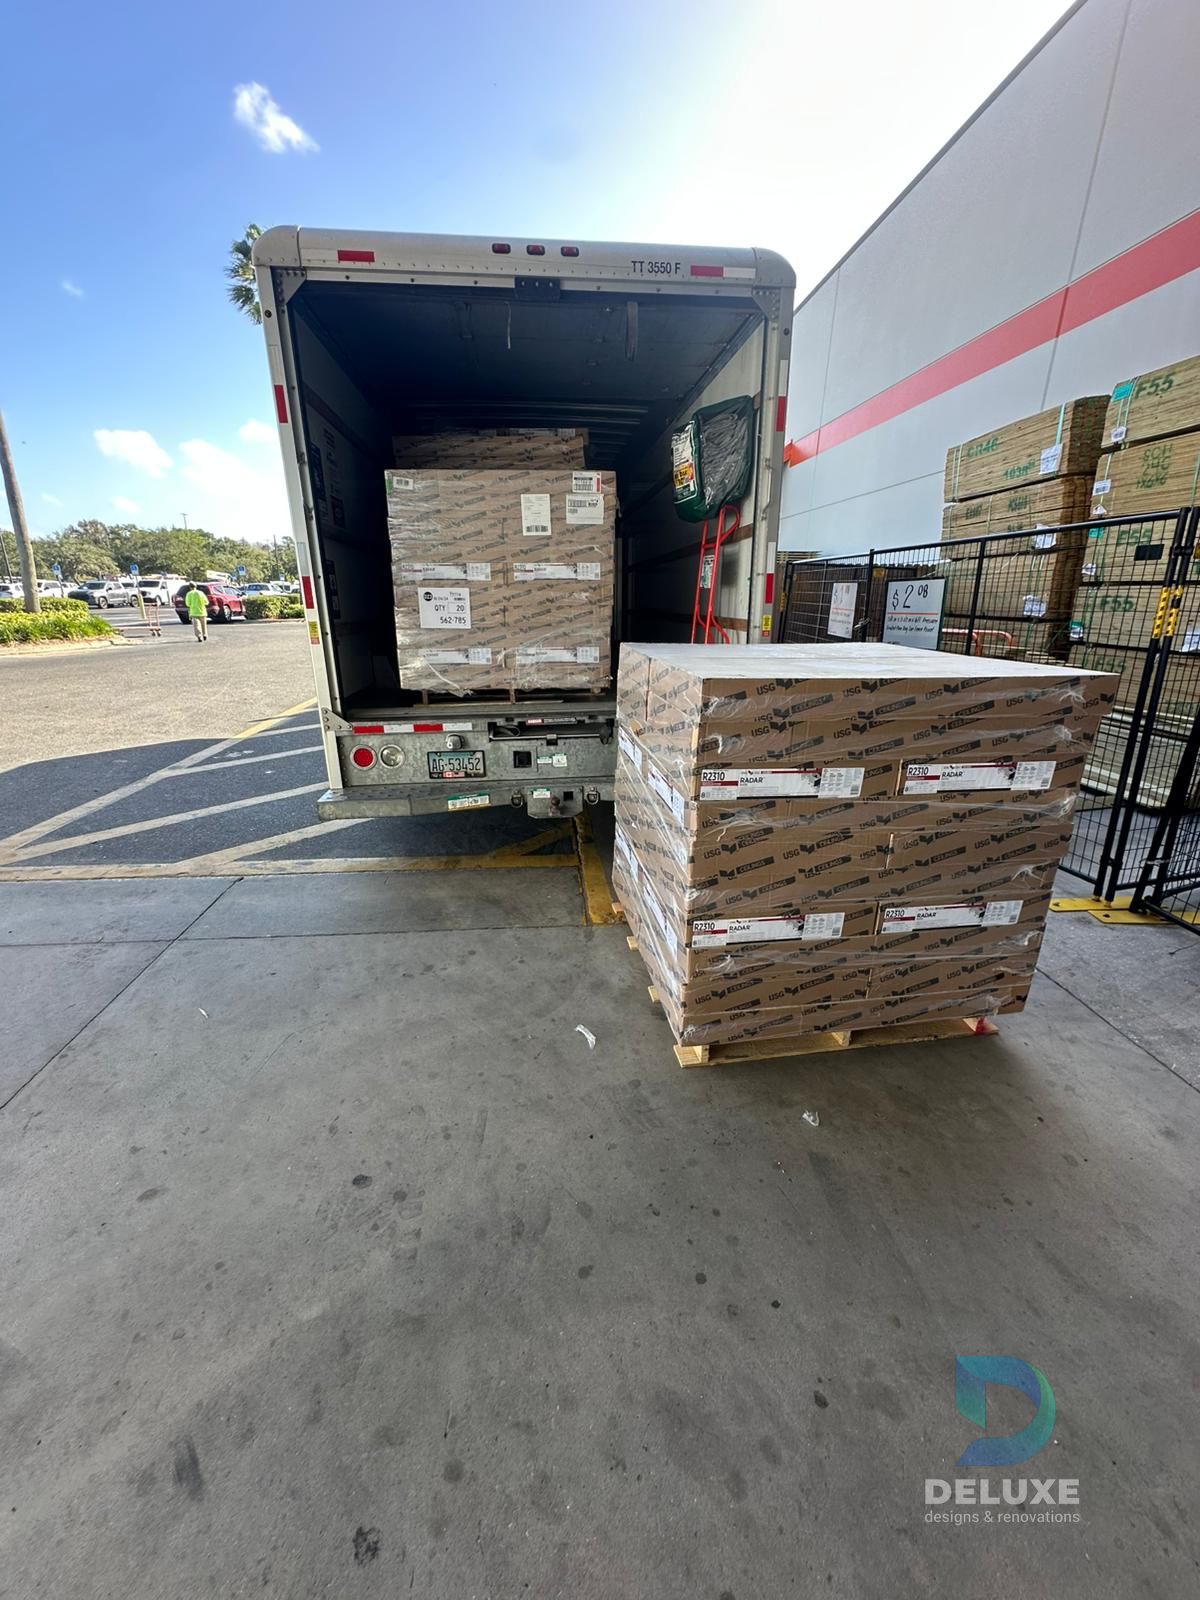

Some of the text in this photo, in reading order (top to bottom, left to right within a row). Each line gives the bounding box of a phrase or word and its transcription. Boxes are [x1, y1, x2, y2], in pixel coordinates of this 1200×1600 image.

[631, 260, 682, 274] TT 3550 F
[434, 603, 466, 613] QTY 20
[756, 683, 776, 695] USG
[842, 686, 862, 698] USG
[925, 688, 943, 701] USG
[1006, 696, 1024, 709] USG
[751, 726, 770, 737] USG
[833, 728, 852, 740] USG
[913, 730, 931, 742] USG
[992, 736, 1009, 747] USG
[702, 771, 762, 785] R2310 RADAR
[908, 766, 964, 779] R2310 RADAR
[903, 839, 920, 850] USG
[974, 838, 991, 850] USG
[1044, 838, 1060, 849] USG
[704, 848, 722, 860] USG
[783, 848, 801, 860] USG
[860, 849, 877, 860] USG
[740, 861, 767, 873] CEILINGS
[818, 858, 844, 871] CEILINGS
[878, 868, 895, 880] USG
[951, 868, 967, 880] USG
[726, 894, 744, 905] USG
[886, 909, 905, 918] R2310
[694, 922, 716, 932] R2310
[880, 972, 896, 983] USG
[947, 970, 962, 980] USG
[695, 994, 712, 1006] USG
[769, 991, 785, 1002] USG
[729, 1011, 745, 1021] USG
